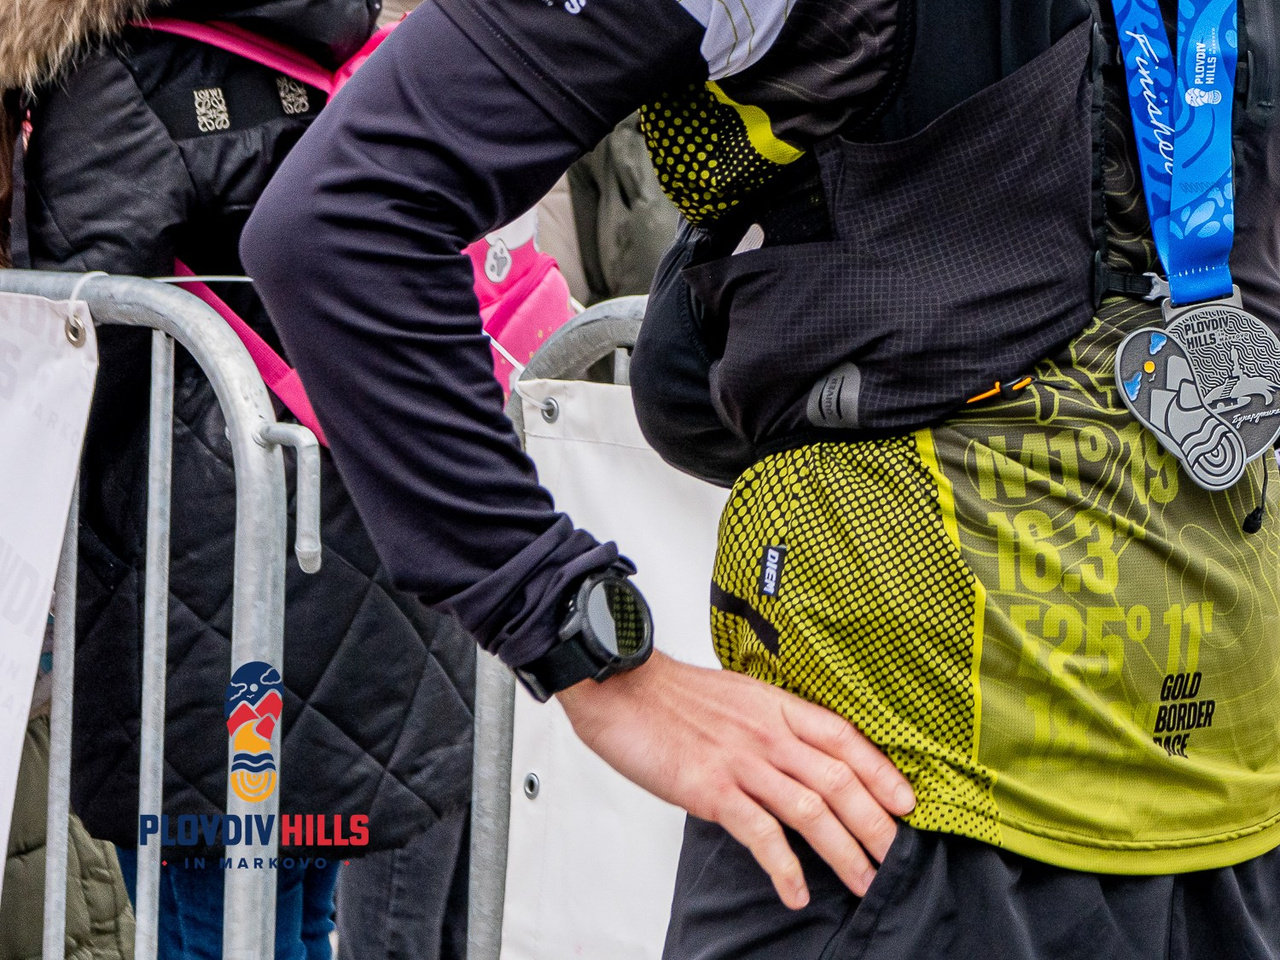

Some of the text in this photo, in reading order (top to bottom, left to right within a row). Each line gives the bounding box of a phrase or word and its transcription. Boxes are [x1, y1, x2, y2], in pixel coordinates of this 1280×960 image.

[1194, 42, 1206, 85] PLOVDIV
[1205, 56, 1217, 85] HILLS
[1184, 316, 1230, 336] PLOVDIV
[1187, 333, 1217, 350] HILLS
[763, 548, 780, 595] DIEM
[1160, 672, 1202, 701] GOLD
[1154, 700, 1216, 733] BORDER
